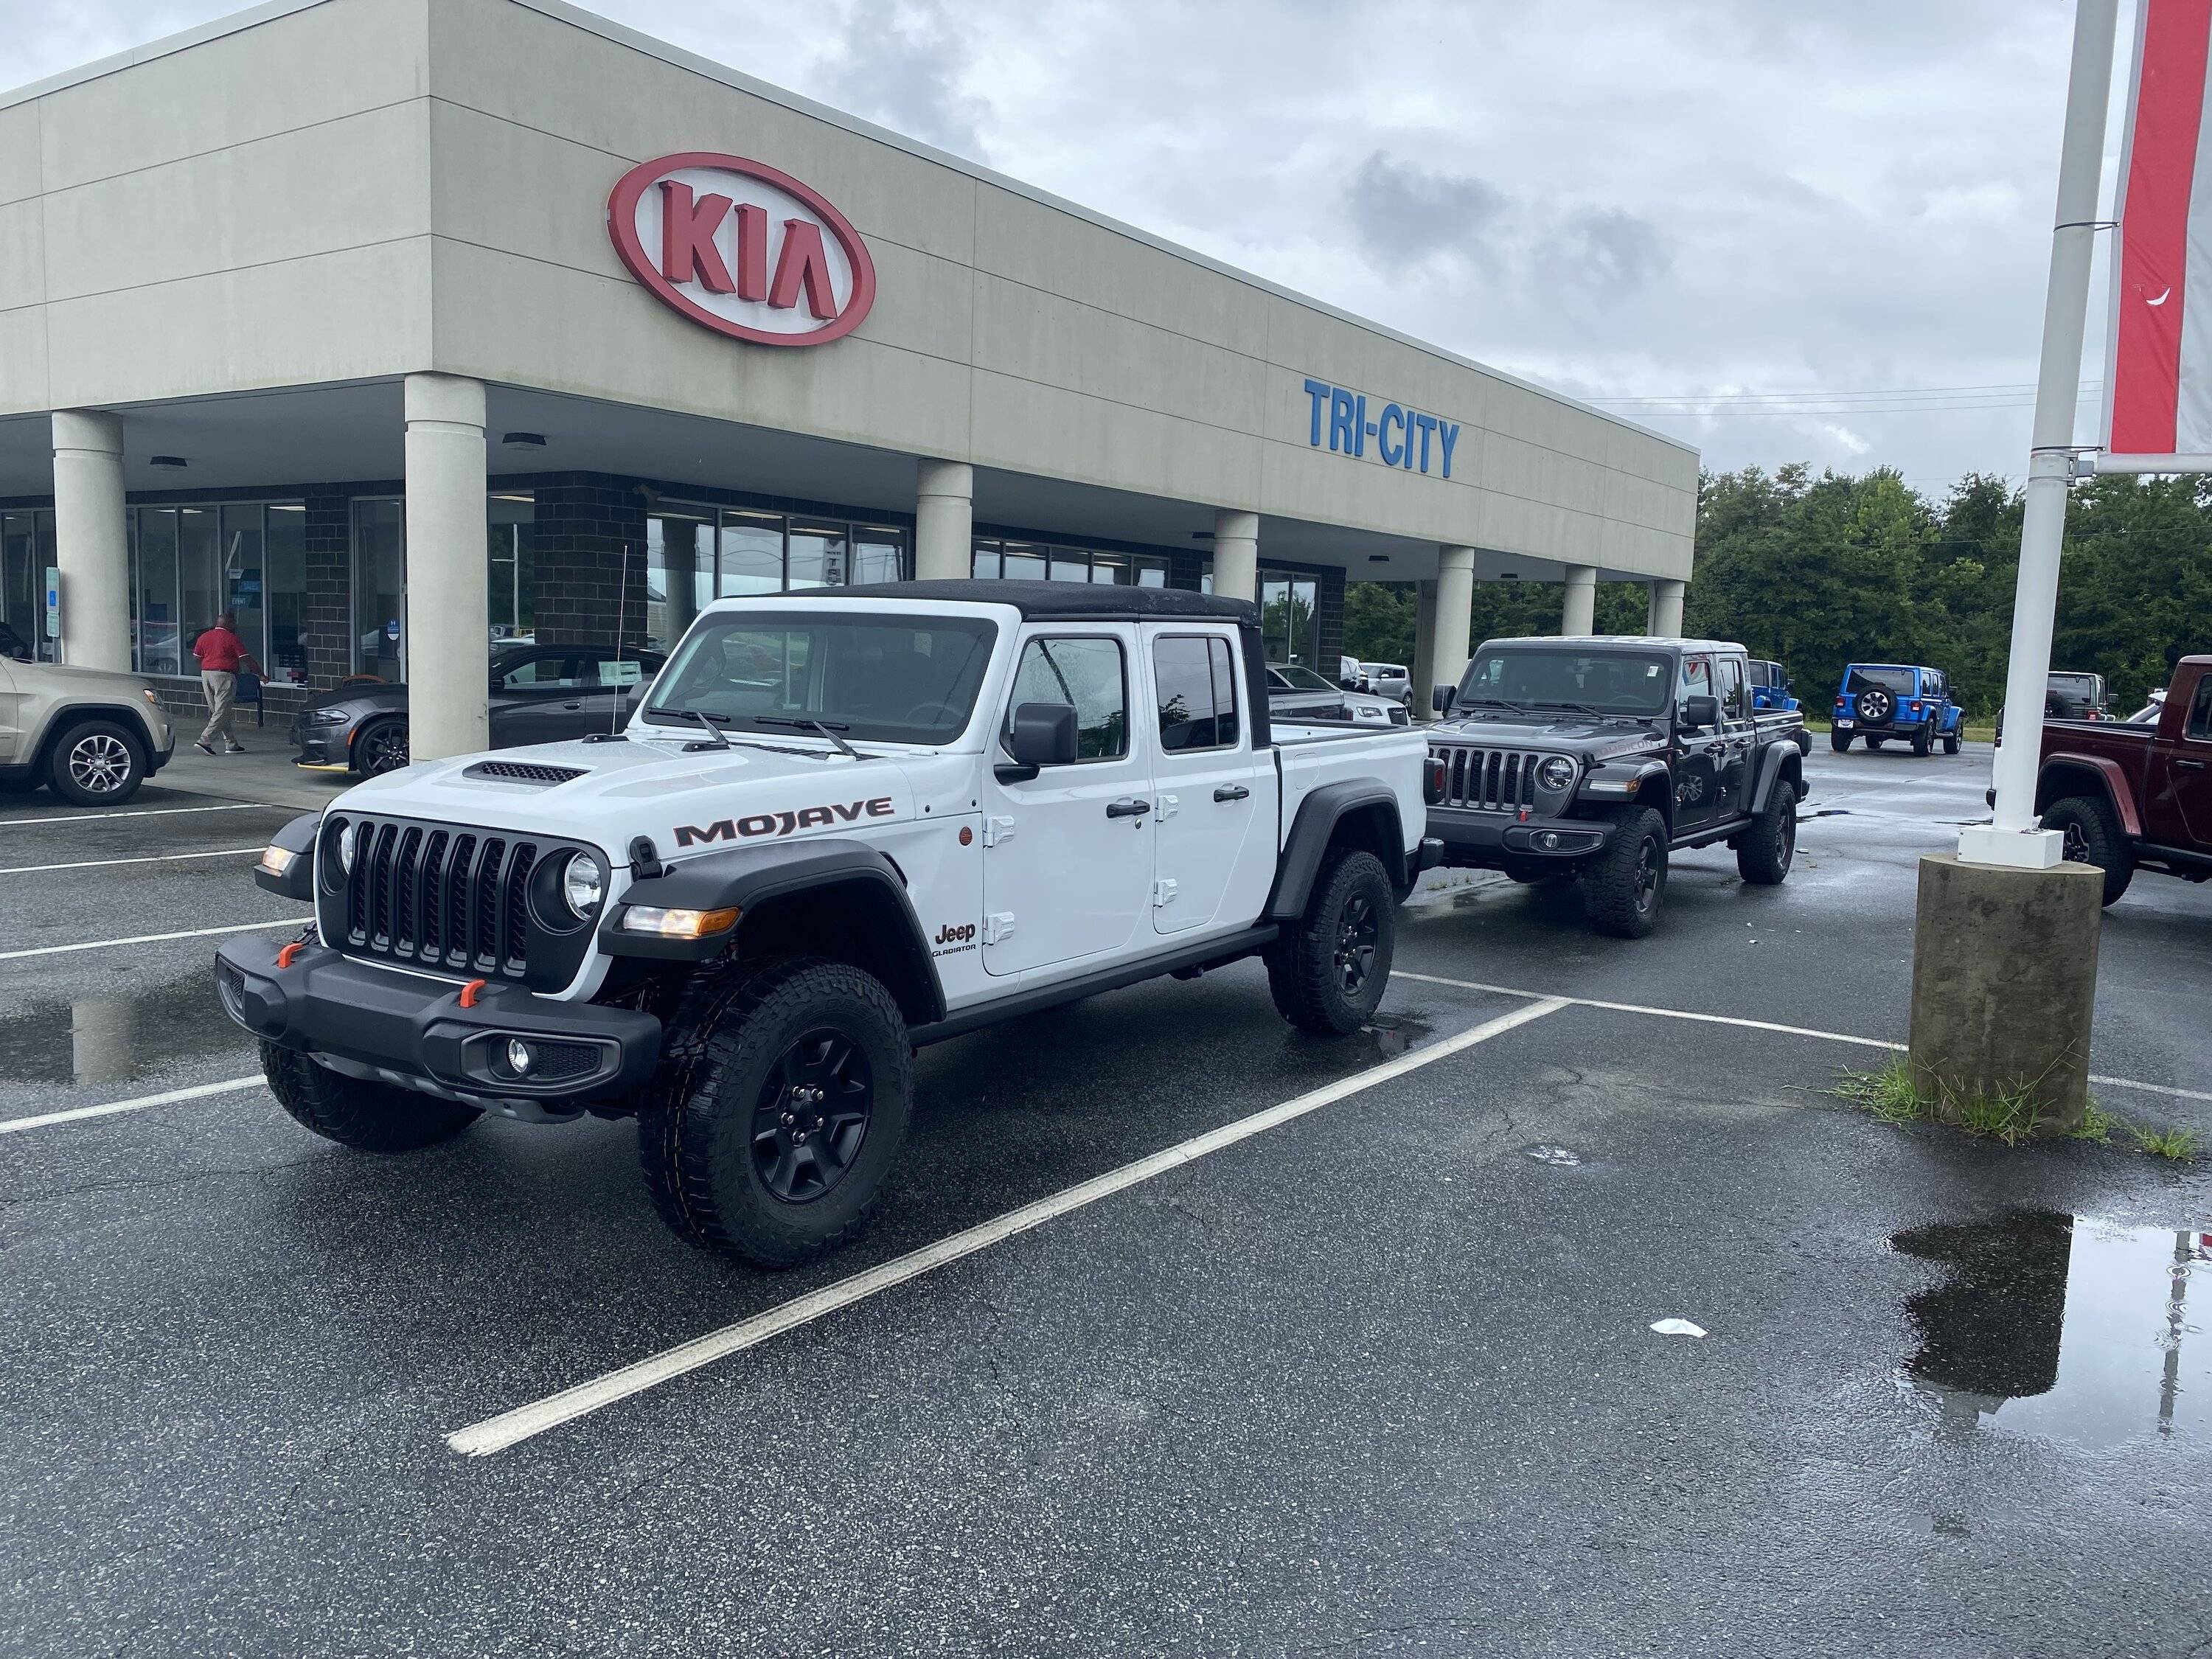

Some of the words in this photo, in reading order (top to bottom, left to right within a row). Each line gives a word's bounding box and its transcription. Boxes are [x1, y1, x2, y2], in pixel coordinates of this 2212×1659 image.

[658, 180, 838, 319] KIA
[1304, 378, 1460, 478] TRI-CITY
[672, 796, 896, 847] MOJAVE
[932, 944, 976, 957] GLADIATOR
[935, 923, 975, 945] Jeep
